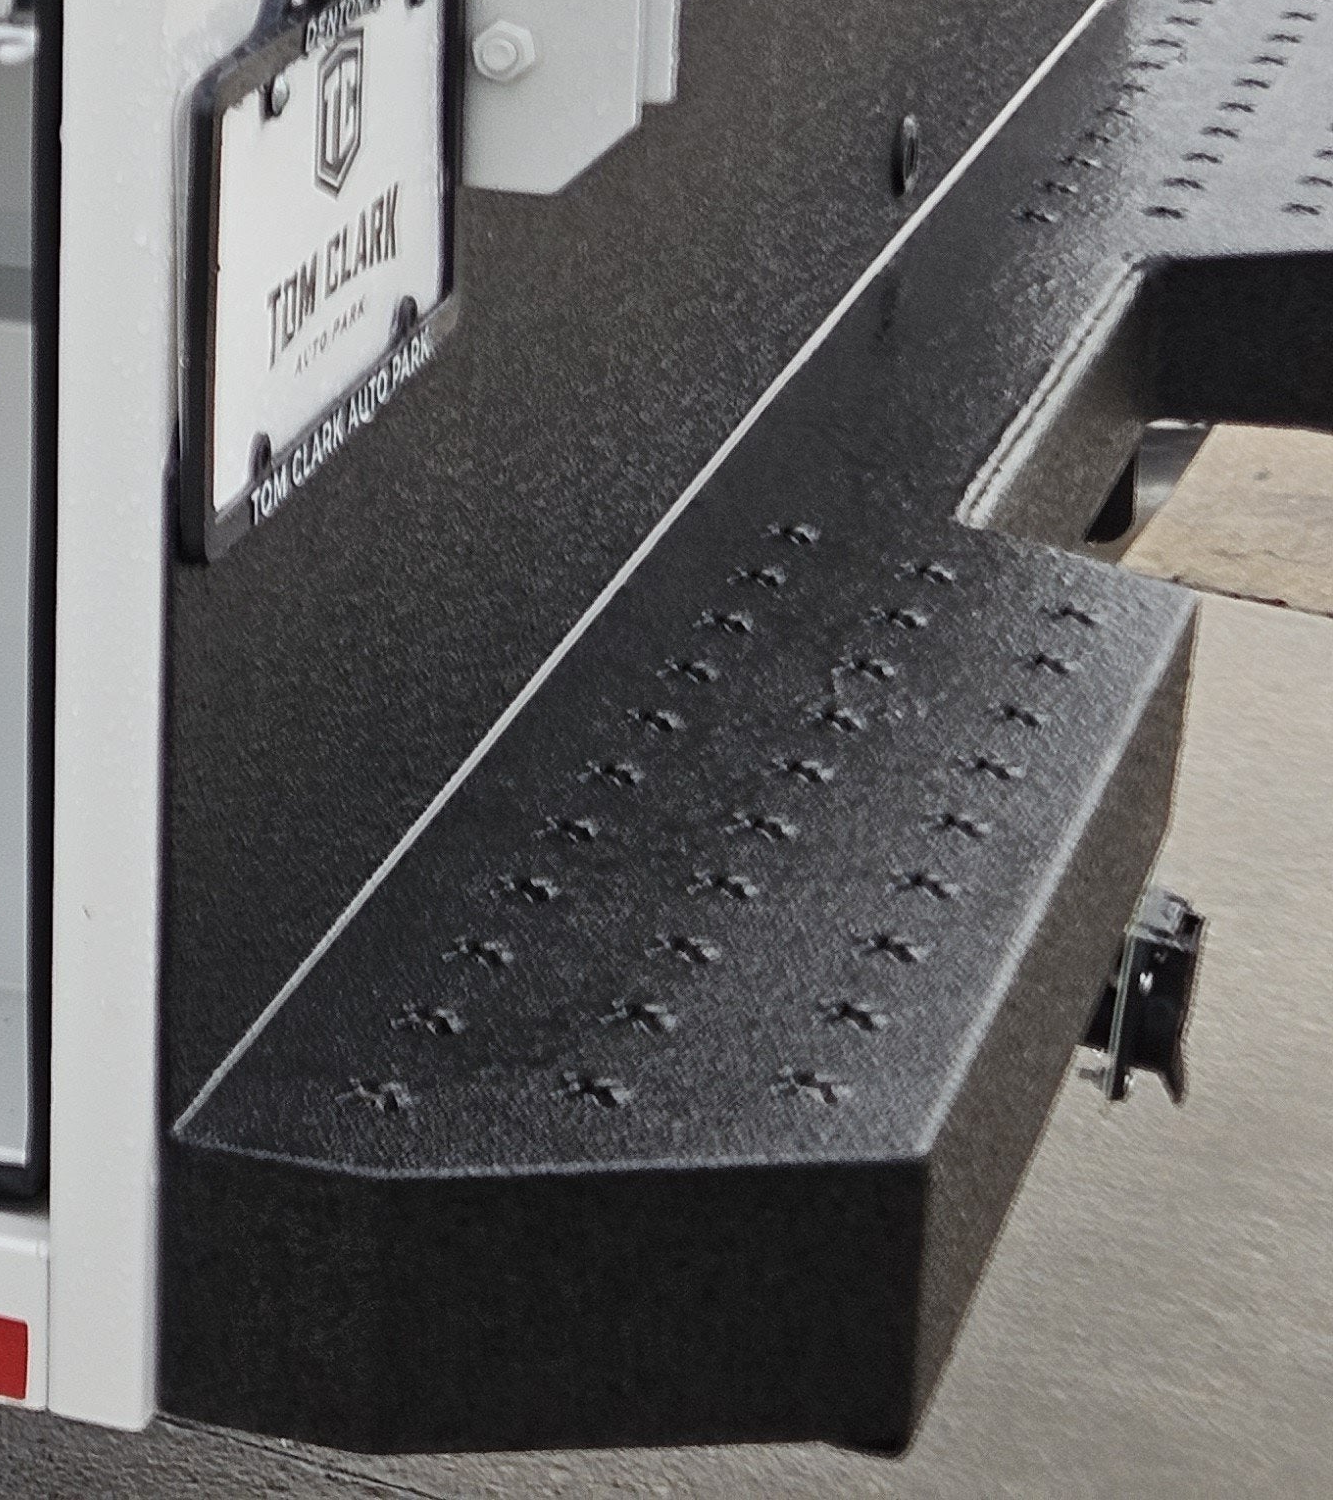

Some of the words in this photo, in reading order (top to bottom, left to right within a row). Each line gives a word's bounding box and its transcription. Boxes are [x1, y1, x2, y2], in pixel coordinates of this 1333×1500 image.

[267, 251, 318, 372] TOM
[324, 182, 398, 299] CLARK
[294, 331, 328, 378] AUTO
[332, 295, 366, 340] PARK
[250, 466, 289, 526] TOM
[291, 406, 344, 487] CLARK
[347, 367, 388, 433] AUTO
[391, 327, 432, 389] PARK
